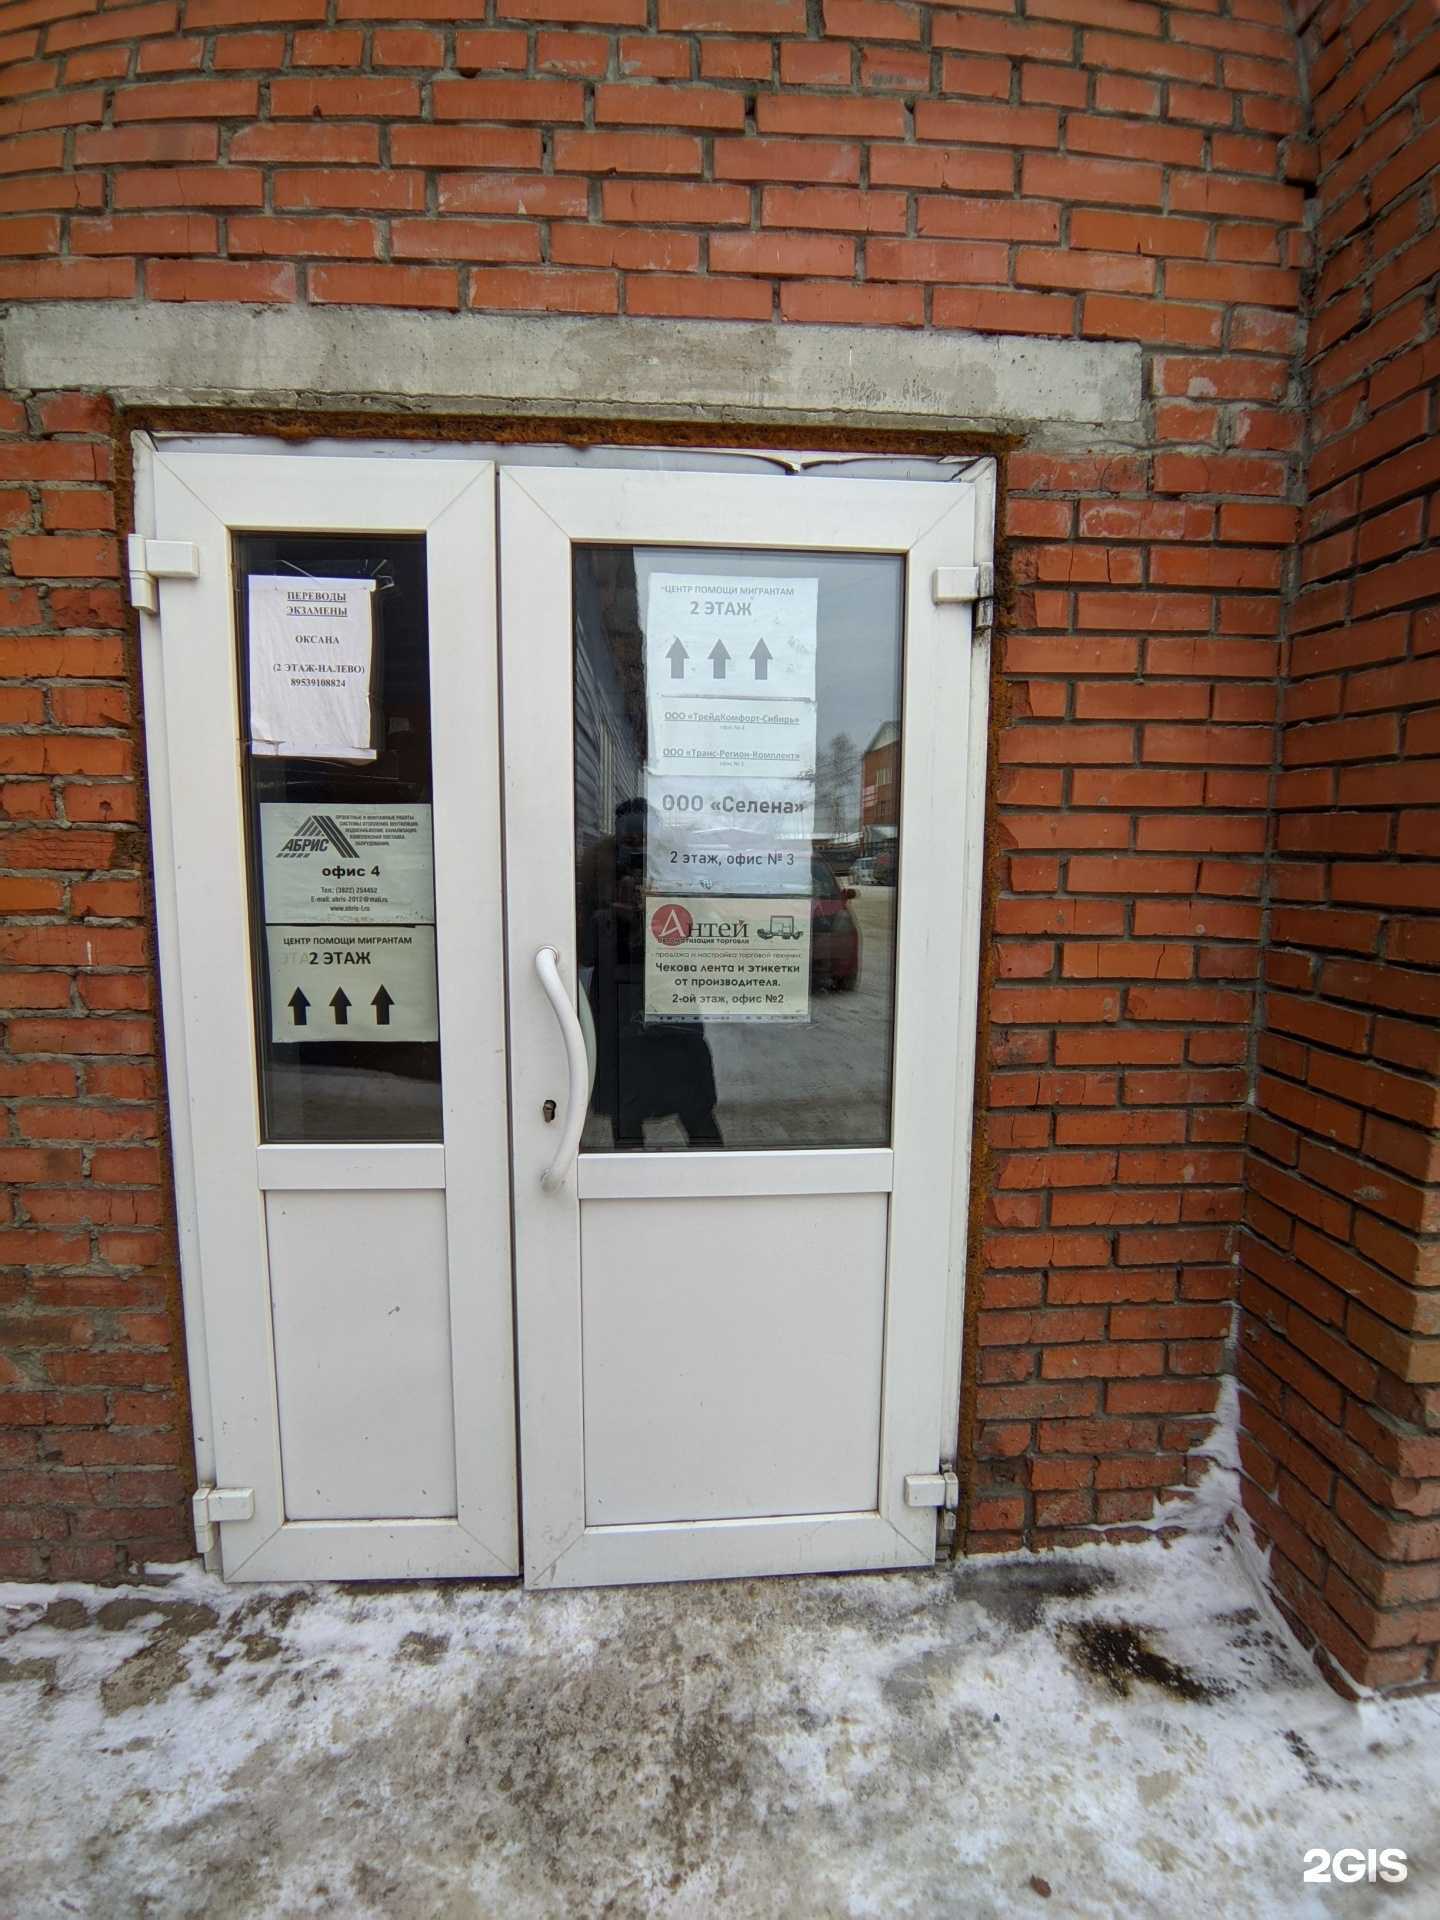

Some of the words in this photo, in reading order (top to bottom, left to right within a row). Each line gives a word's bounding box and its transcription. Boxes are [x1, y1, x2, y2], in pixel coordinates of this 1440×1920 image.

[664, 585, 692, 593] ЦЕНТР
[694, 586, 738, 595] ПОМОЩИ
[739, 587, 795, 595] МИГРАНТАМ
[287, 591, 346, 602] ПЕРЕВОДЫ
[286, 606, 348, 617] ЭКЗАМЕНЫ
[690, 601, 699, 615] 2
[703, 601, 752, 616] ЭТАЖ
[295, 635, 339, 645] ОКСАНА
[273, 663, 282, 673] (2
[286, 664, 365, 674] ЭТАЖ-НАЛЕВО)
[290, 679, 346, 688] 89539108824
[664, 711, 686, 721] ООО
[663, 748, 684, 758] ООО
[662, 794, 704, 811] ООО
[710, 795, 805, 814] «Селена»
[281, 838, 329, 852] АБРИС
[669, 851, 678, 864] 2
[682, 852, 722, 866] этаж,
[726, 852, 763, 867] офис
[767, 852, 783, 865] №
[787, 853, 794, 865] 3
[322, 865, 366, 879] офис
[371, 866, 380, 877] 4
[660, 909, 748, 938] Антей
[283, 937, 311, 946] ЦЕНТР
[313, 937, 355, 946] ПОМОЩИ
[357, 936, 412, 946] МИГРАНТАМ
[309, 952, 319, 965] 2
[323, 951, 372, 965] ЭТАЖ
[655, 962, 698, 973] Чекова
[700, 963, 735, 973] лента
[738, 964, 745, 973] и
[748, 963, 800, 973] этикетки
[674, 978, 688, 987] от
[691, 978, 781, 988] производителя.
[672, 993, 697, 1004] 2-ой
[700, 994, 729, 1005] этаж,
[732, 993, 762, 1005] офис
[765, 993, 784, 1004] №2
